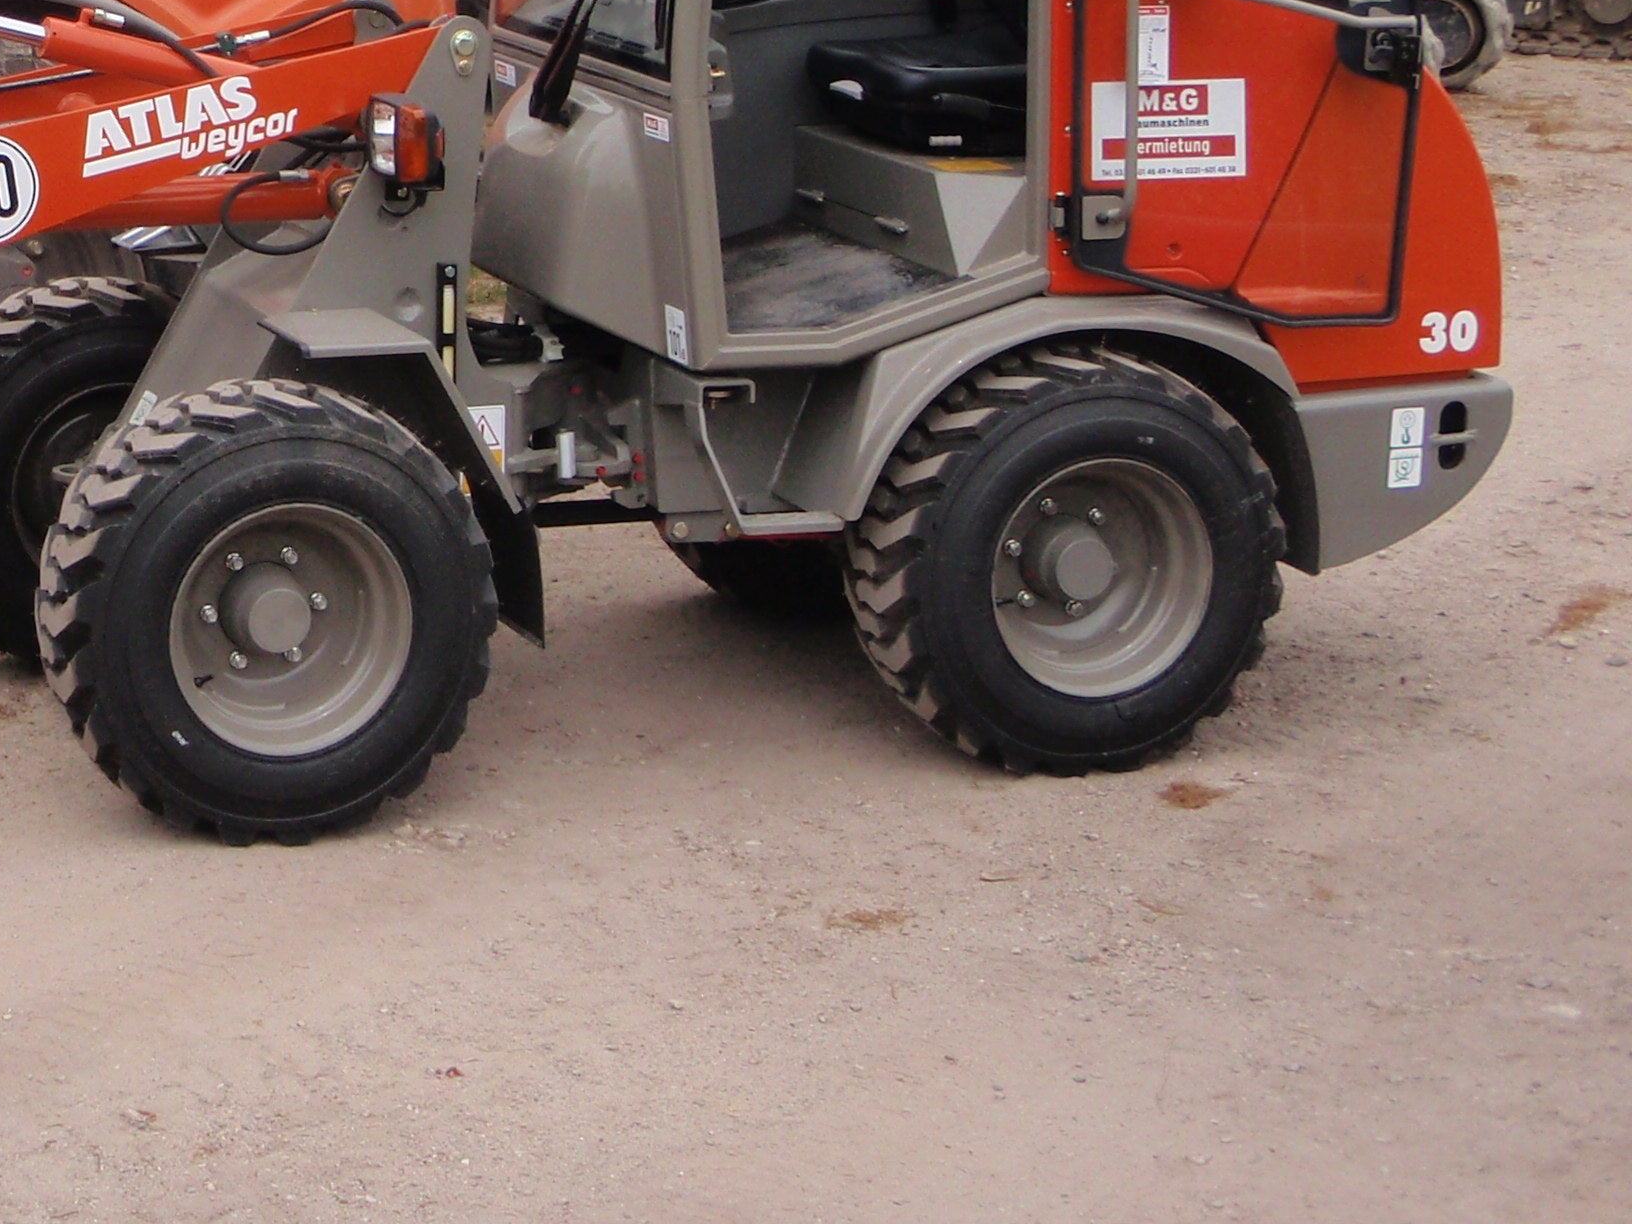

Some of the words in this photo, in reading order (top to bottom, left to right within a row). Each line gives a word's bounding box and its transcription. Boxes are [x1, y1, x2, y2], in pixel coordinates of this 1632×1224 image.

[84, 76, 258, 159] ATLAS
[1138, 87, 1199, 112] M&G
[181, 108, 299, 160] weycor
[1134, 138, 1211, 156] ermietung
[1418, 309, 1479, 354] 30
